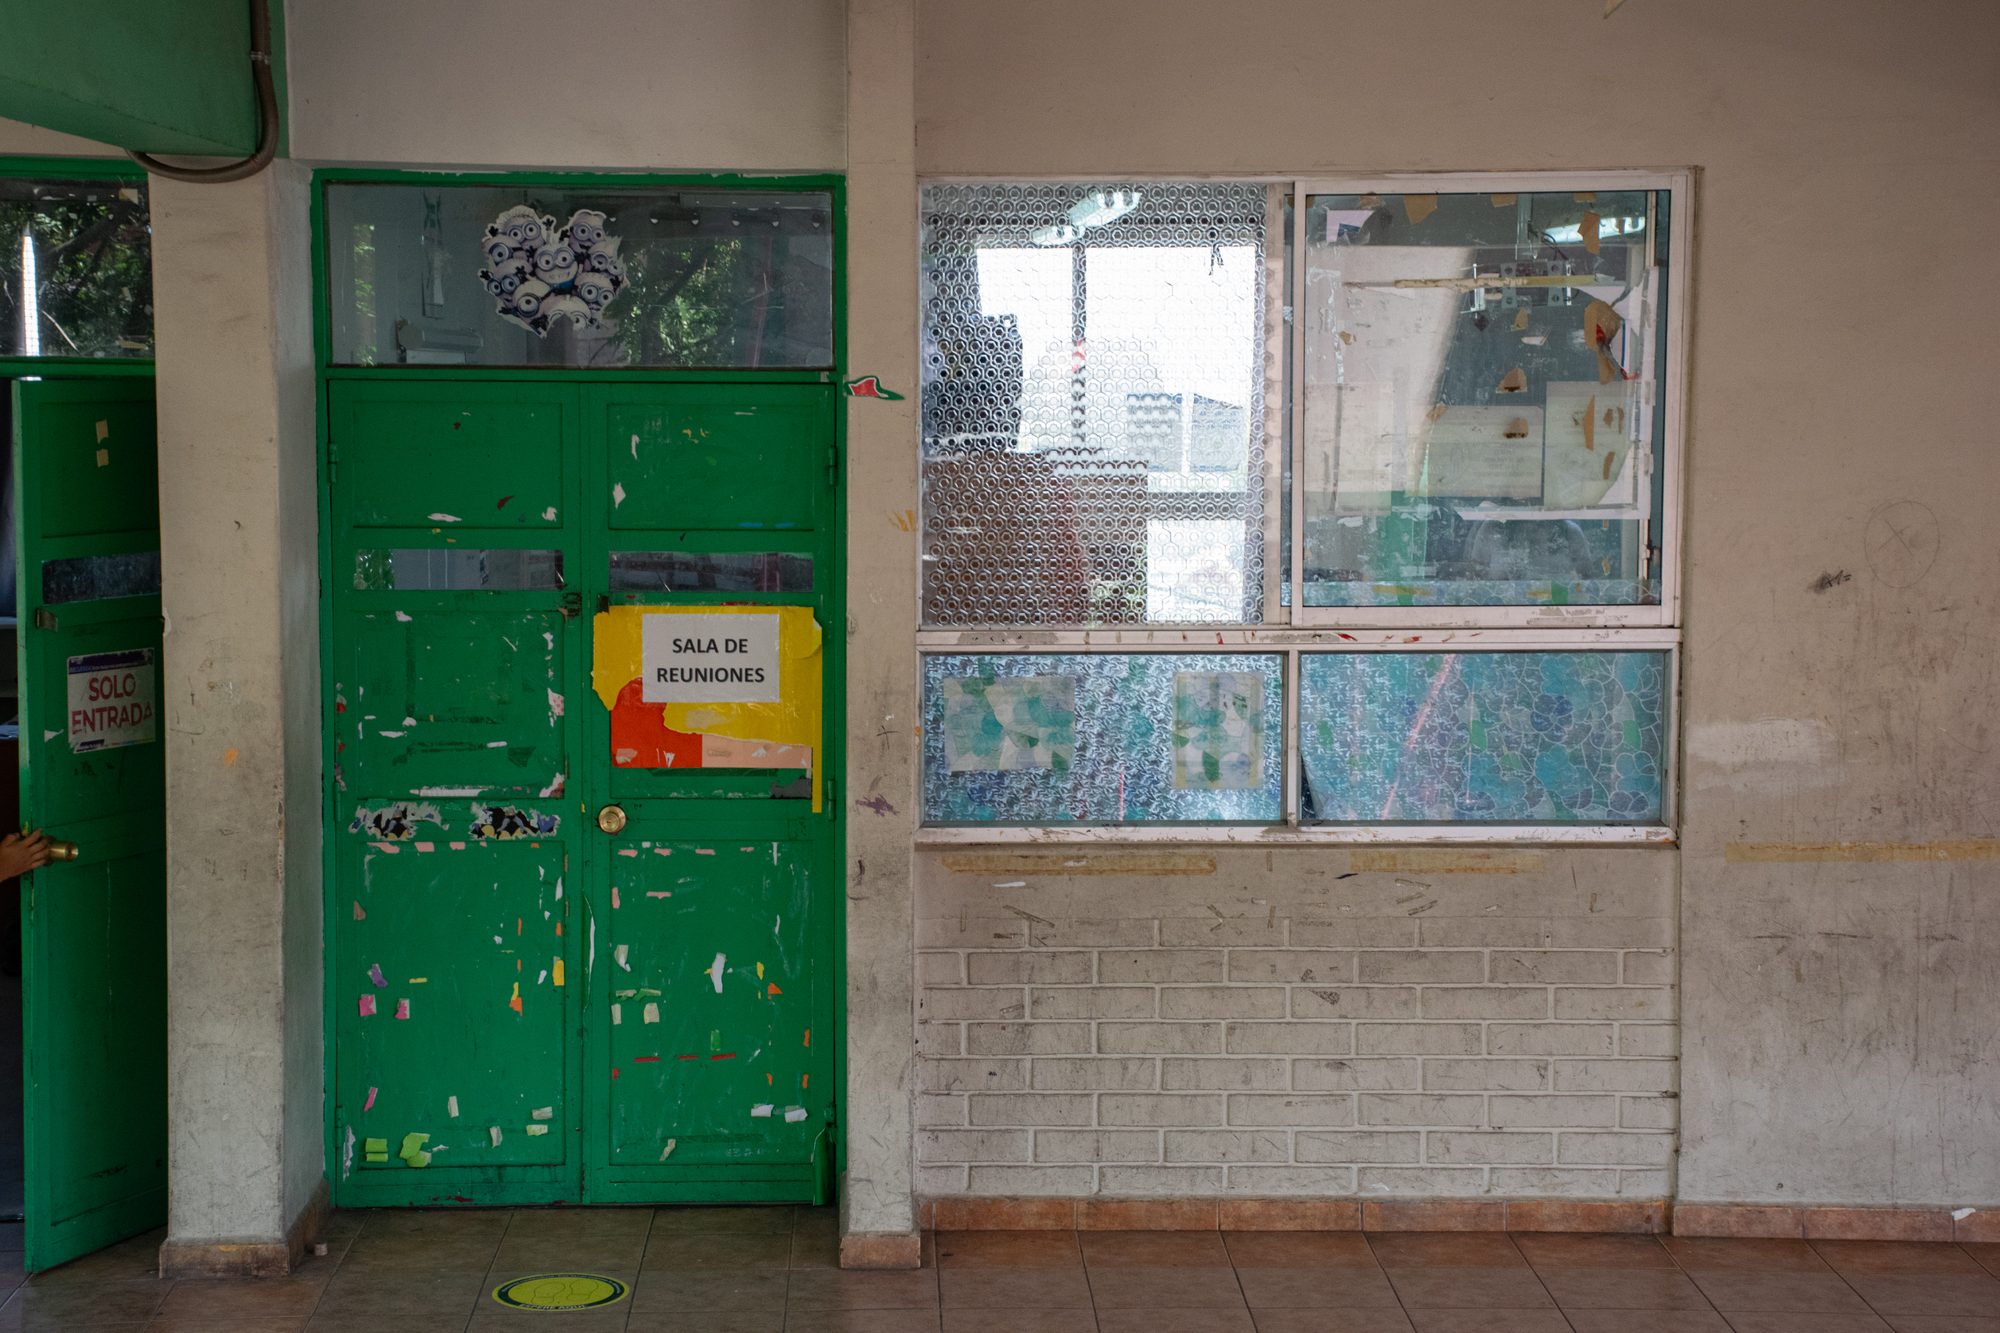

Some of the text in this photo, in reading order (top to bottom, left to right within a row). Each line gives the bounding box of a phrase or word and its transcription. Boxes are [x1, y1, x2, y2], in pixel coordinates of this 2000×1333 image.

[672, 638, 749, 654] SALA DE
[656, 667, 765, 683] REUNIONES
[89, 672, 136, 702] SOLO
[71, 701, 153, 735] ENTRADA
